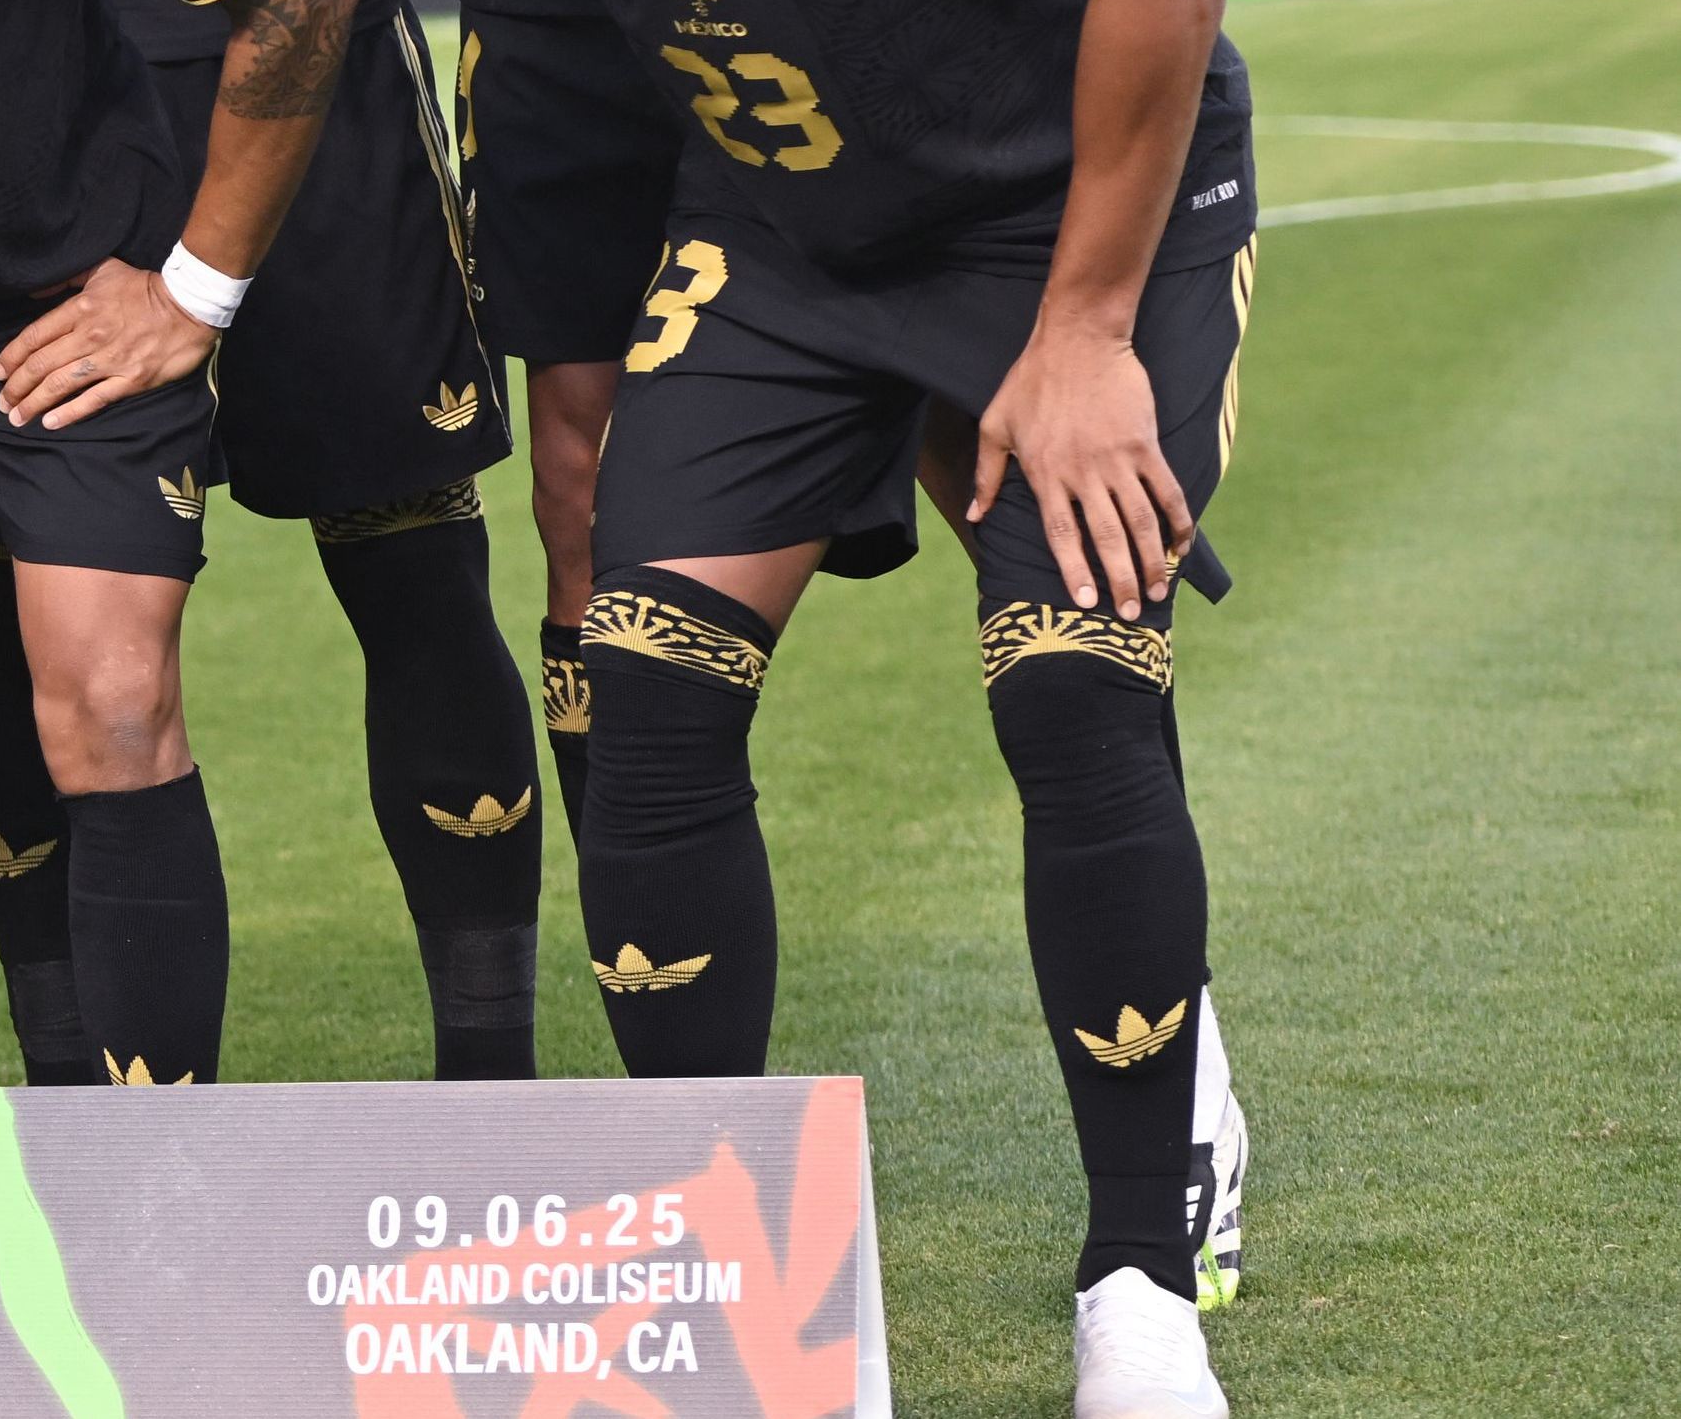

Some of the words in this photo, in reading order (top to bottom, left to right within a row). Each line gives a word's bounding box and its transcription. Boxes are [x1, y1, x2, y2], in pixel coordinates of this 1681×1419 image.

[673, 16, 748, 38] MÉXICO
[661, 44, 844, 172] 23
[367, 1193, 685, 1249] 09.06.25
[307, 1264, 511, 1306] OAKLAND
[523, 1262, 742, 1305] COLISEUM
[345, 1322, 612, 1380] OAKLAND,
[627, 1321, 700, 1373] CA
